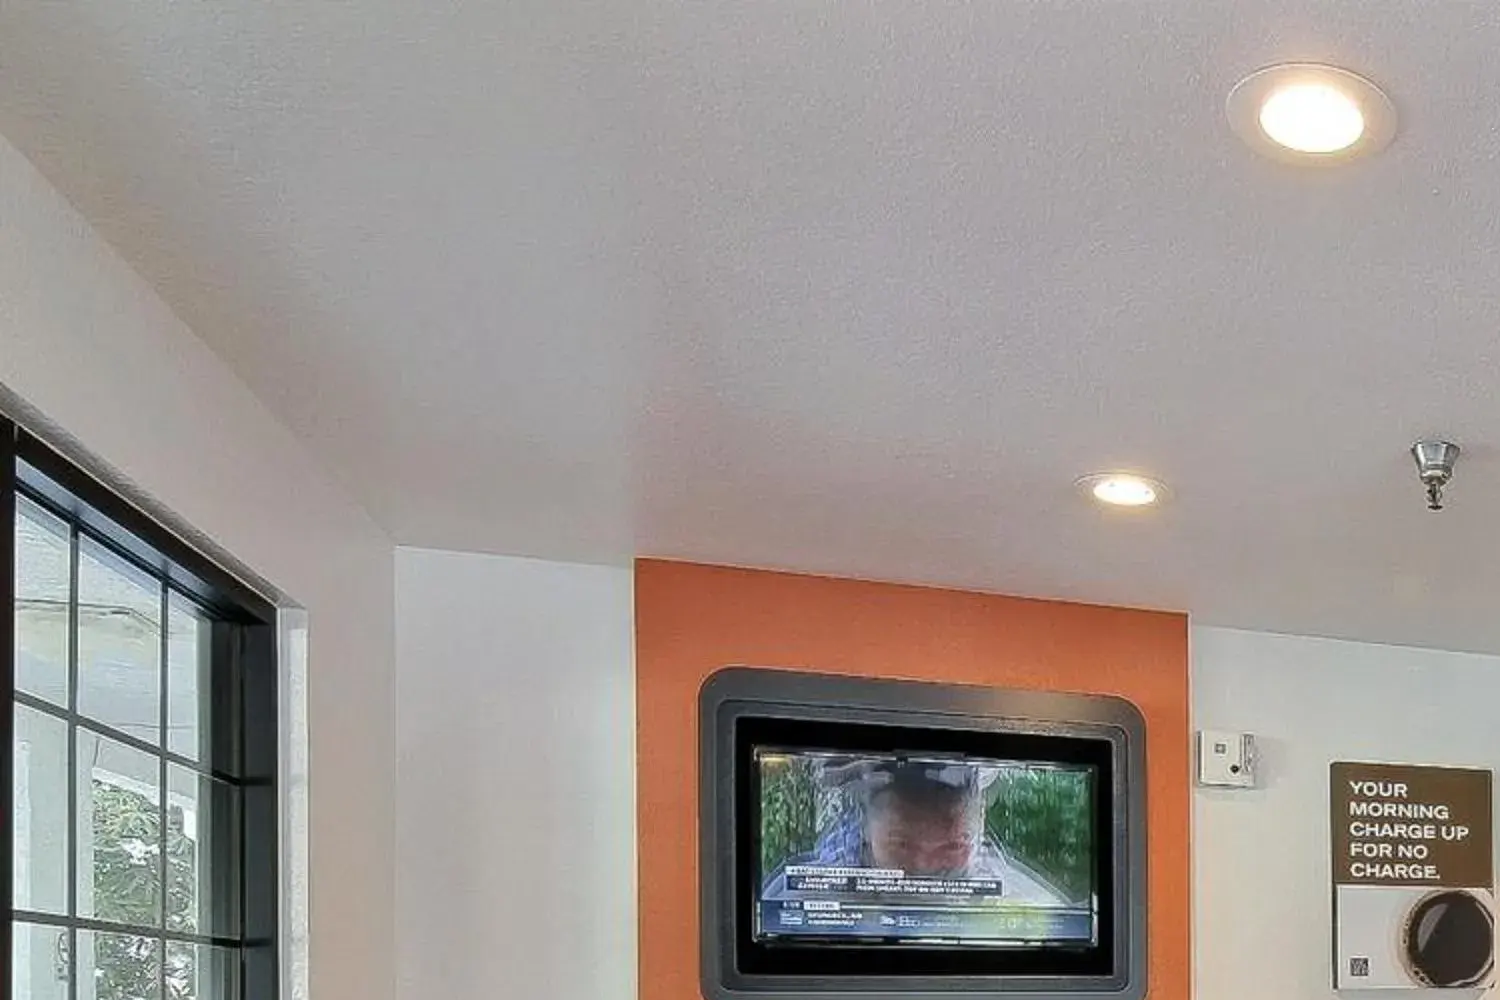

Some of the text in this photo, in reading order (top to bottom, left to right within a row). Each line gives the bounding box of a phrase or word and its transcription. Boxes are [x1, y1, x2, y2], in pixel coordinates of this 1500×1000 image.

[1349, 781, 1408, 798] YOUR
[1349, 801, 1449, 819] MORNING
[1349, 822, 1469, 841] CHARGE UP
[1350, 842, 1428, 859] FOR NO
[1350, 863, 1441, 880] CHARGE.
